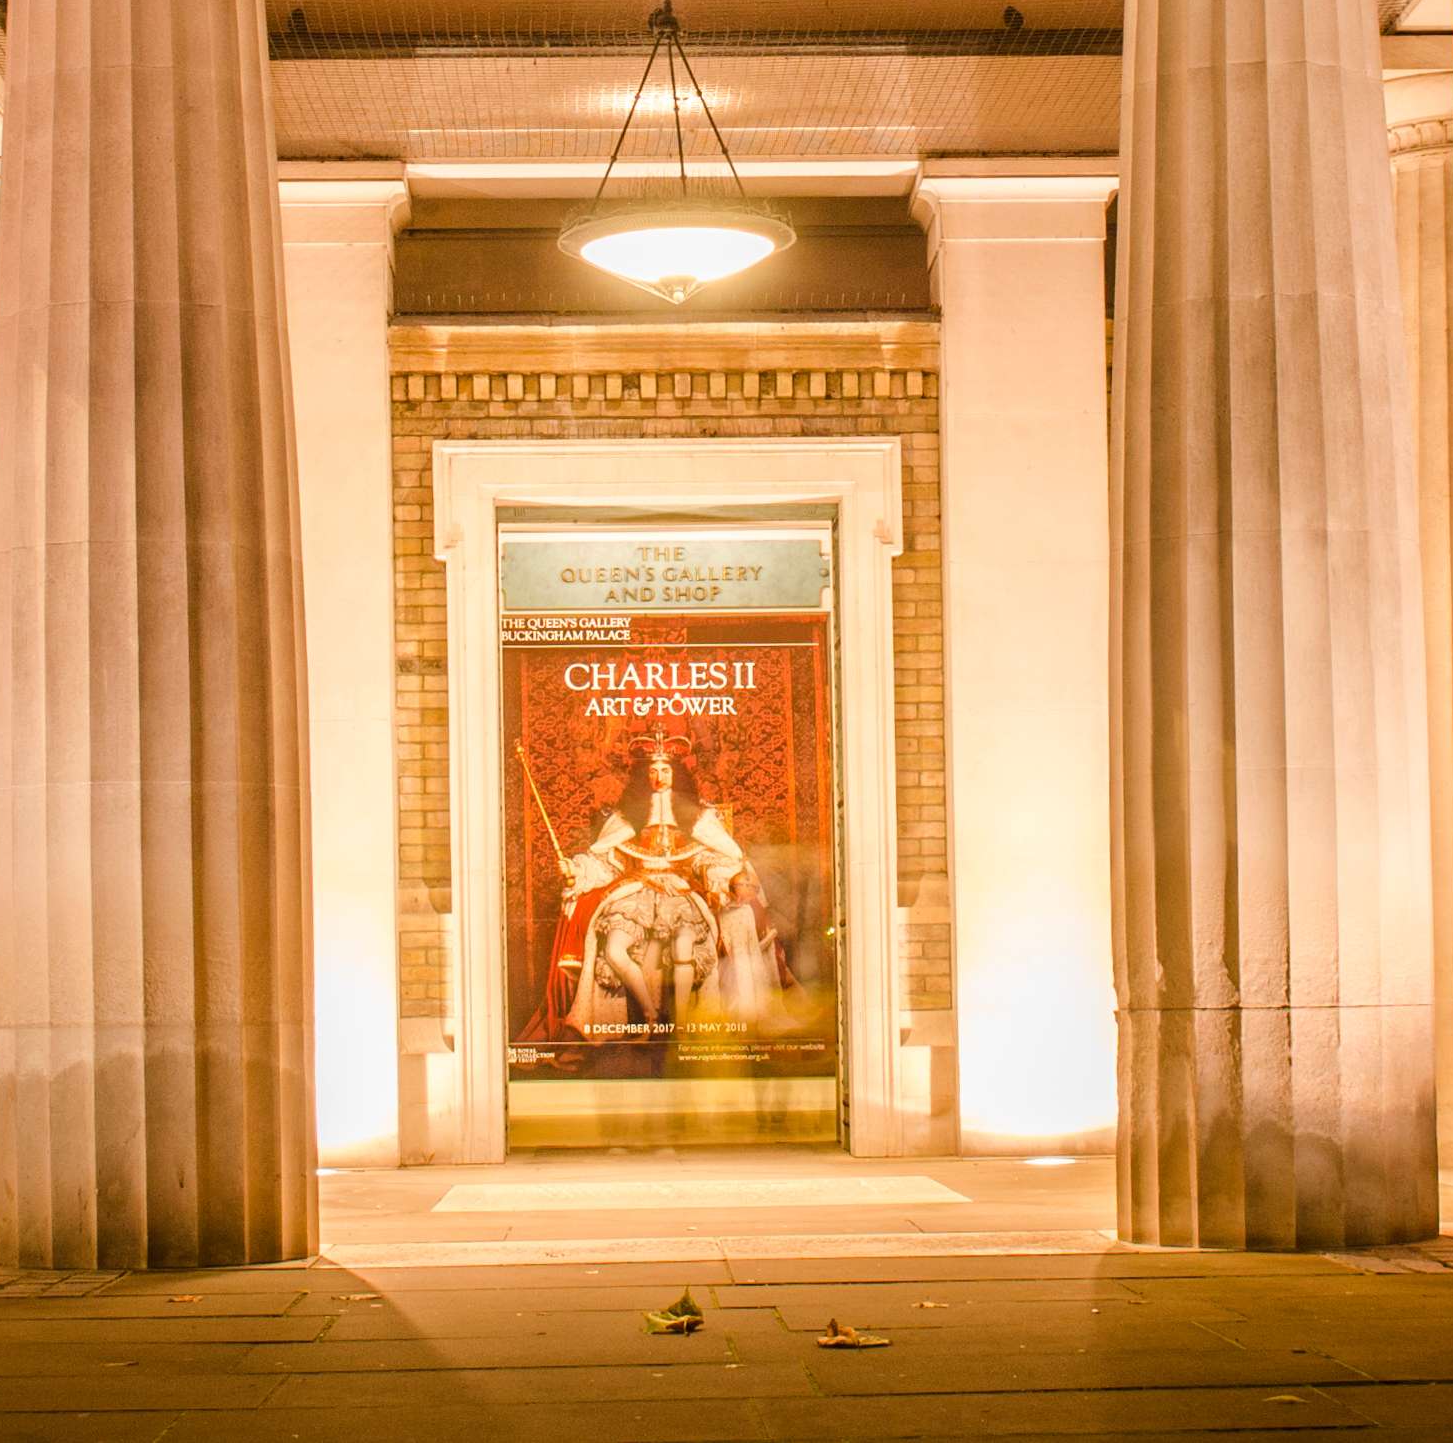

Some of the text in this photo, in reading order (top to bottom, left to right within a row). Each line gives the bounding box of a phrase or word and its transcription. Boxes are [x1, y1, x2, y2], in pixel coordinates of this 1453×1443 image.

[637, 546, 686, 562] THE
[560, 565, 763, 584] QUEEN'S GALLERY
[604, 585, 722, 603] AND SHOP
[502, 617, 631, 630] THE QUEEN'S GALLERY
[502, 628, 631, 641] BUCKINGHAM PALACE
[564, 661, 756, 691] CHARLES II
[584, 692, 737, 717] ART & POWER
[593, 1023, 650, 1034] DECEMBER
[653, 1022, 675, 1034] 2017
[686, 1022, 696, 1033] 13
[699, 1022, 722, 1033] MAY
[725, 1022, 747, 1033] 2018
